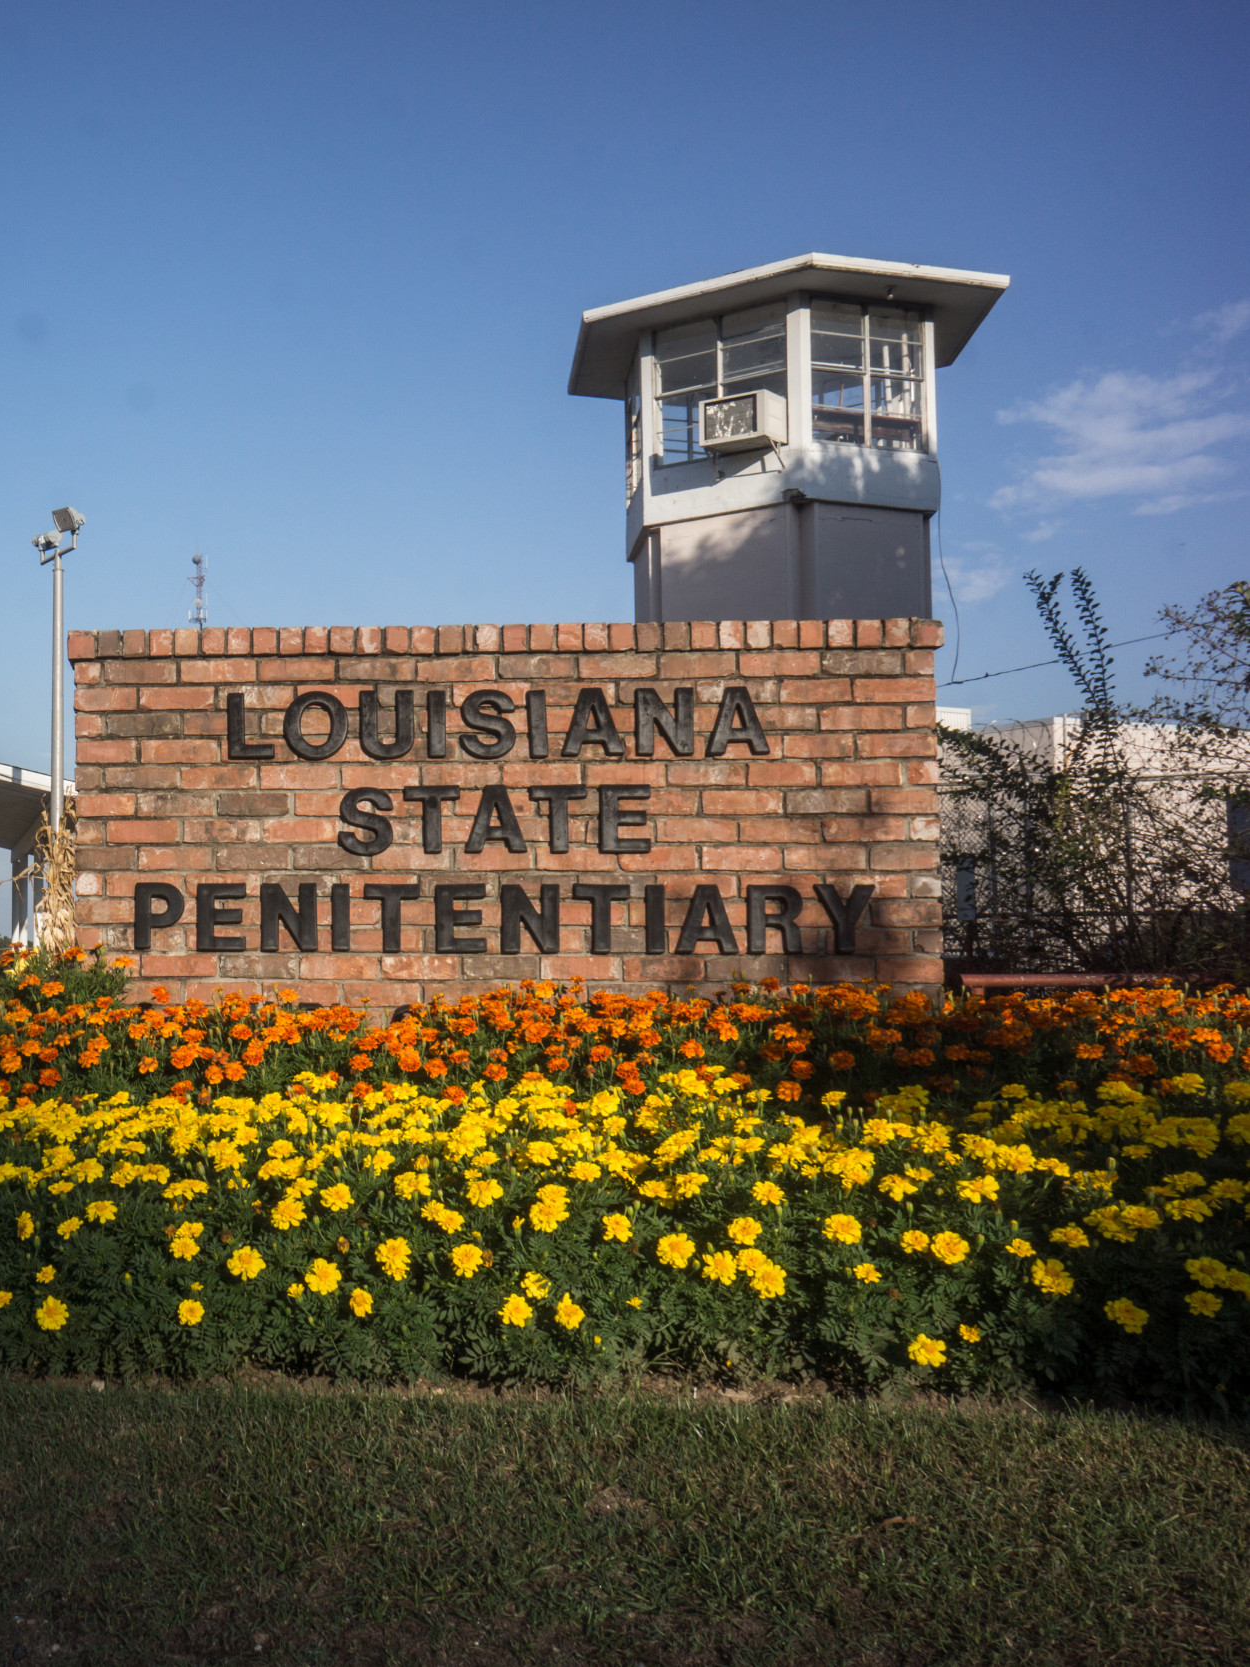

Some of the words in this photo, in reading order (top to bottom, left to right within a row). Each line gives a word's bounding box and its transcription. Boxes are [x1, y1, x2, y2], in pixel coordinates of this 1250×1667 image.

[226, 686, 770, 760] LOUISIANA
[337, 783, 652, 856] STATE
[133, 881, 876, 955] PENITENTIARY
